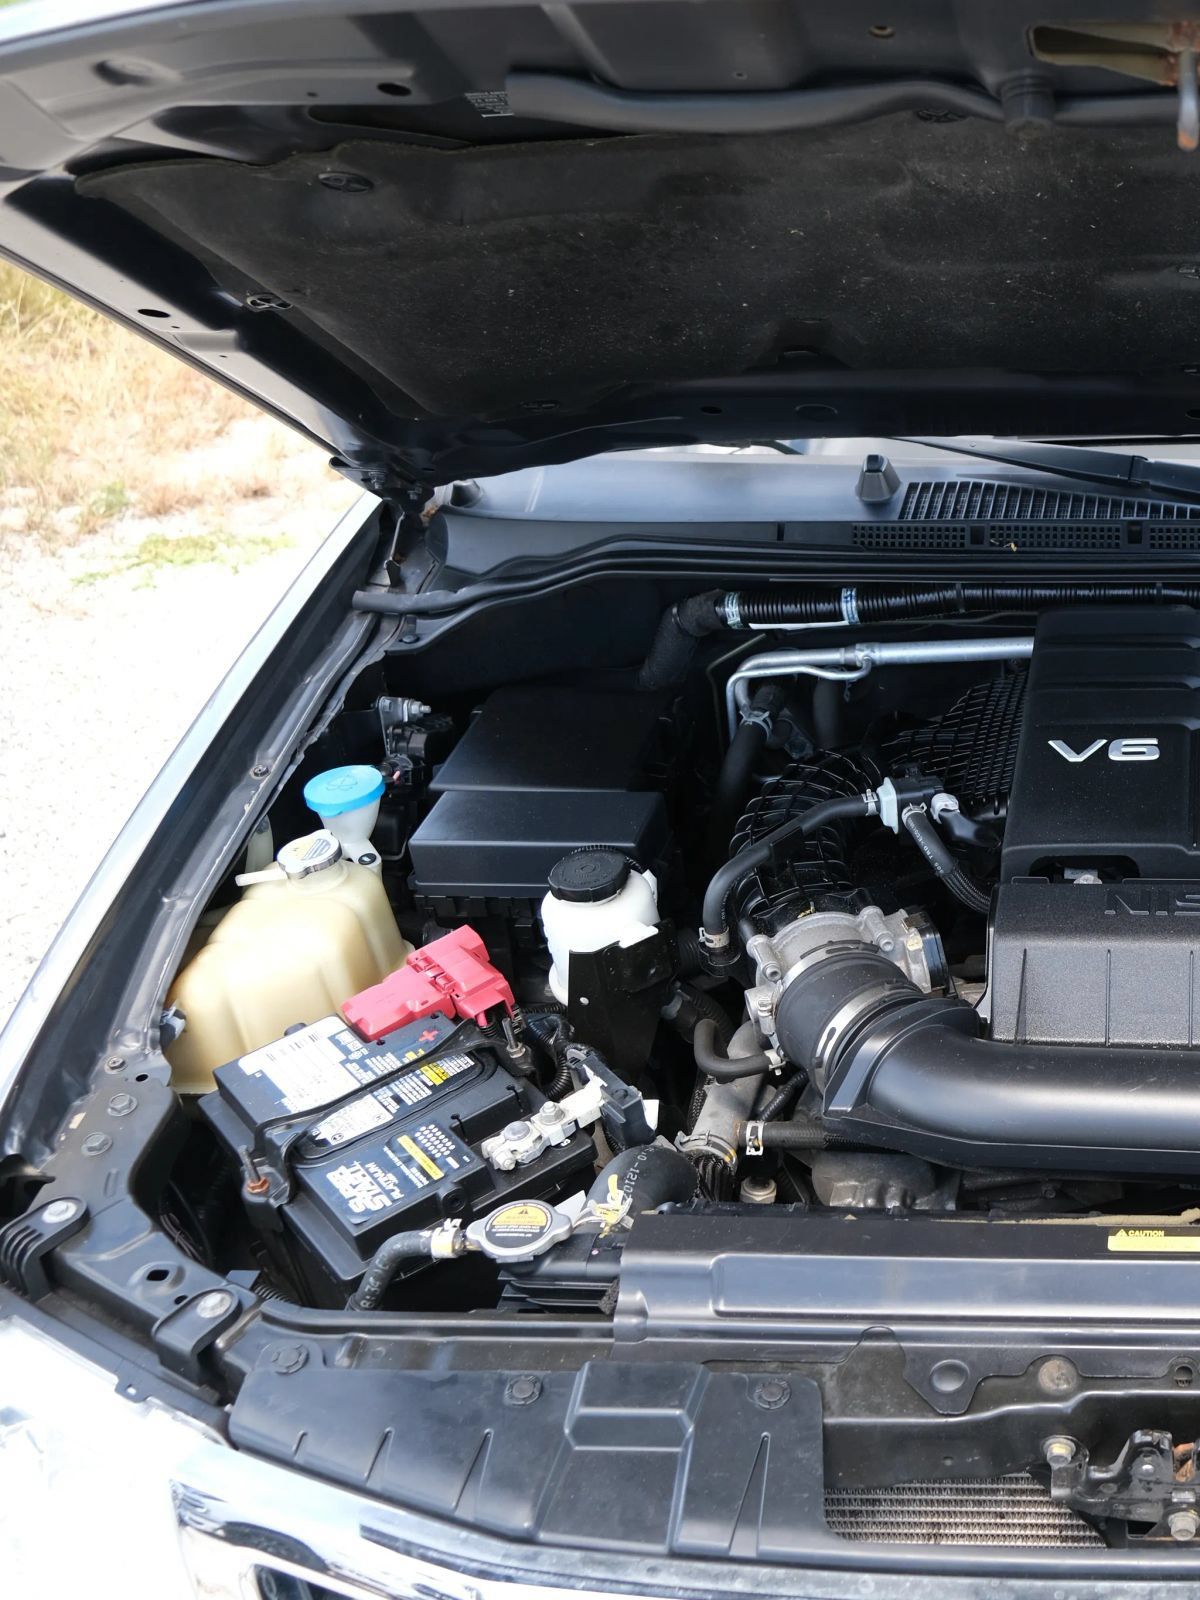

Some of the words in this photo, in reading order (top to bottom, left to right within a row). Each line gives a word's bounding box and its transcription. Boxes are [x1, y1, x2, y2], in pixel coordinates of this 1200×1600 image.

[1047, 737, 1160, 762] V6
[340, 1160, 393, 1212] START
[364, 1162, 404, 1200] PLATINUM
[1128, 1230, 1165, 1238] CAUTION
